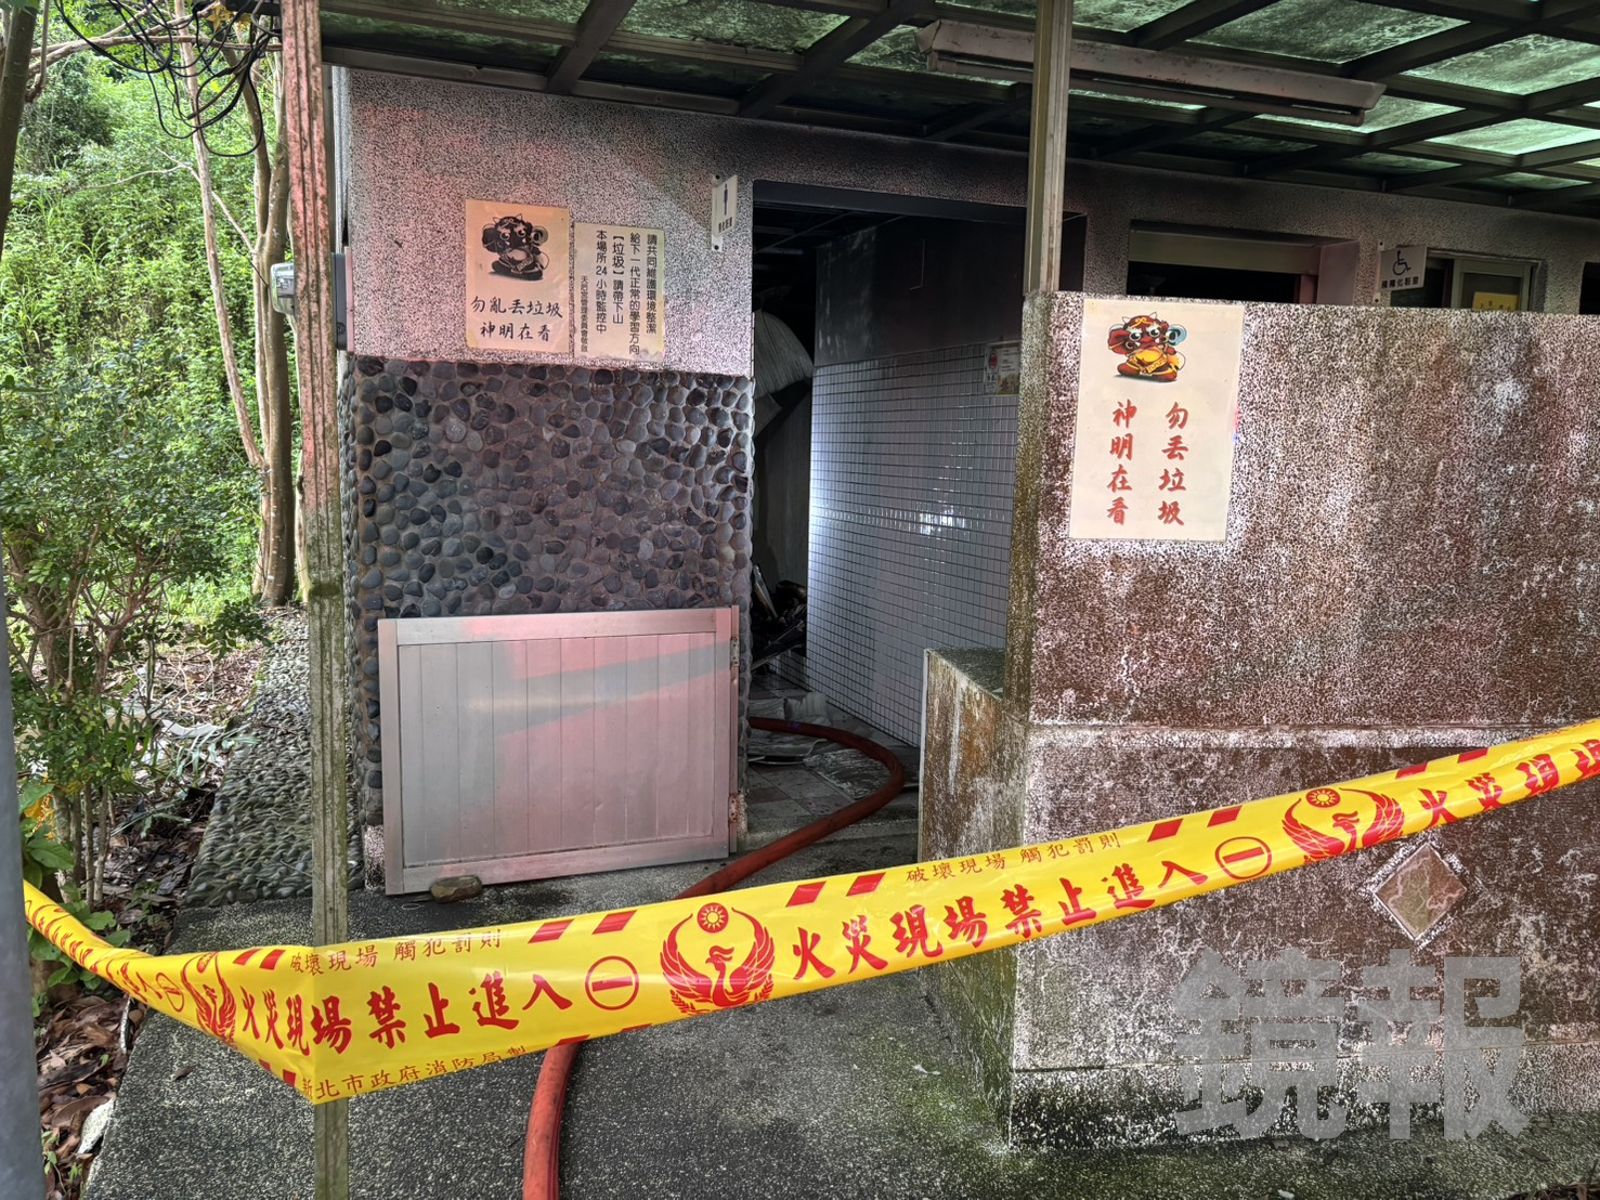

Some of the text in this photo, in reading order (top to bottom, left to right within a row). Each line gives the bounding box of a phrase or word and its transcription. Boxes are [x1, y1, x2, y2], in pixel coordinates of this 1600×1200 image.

[471, 295, 563, 319] 勿亂丟垃圾
[480, 322, 551, 342] 神明在看
[629, 232, 641, 356] 給下一代正常的學習方向
[1106, 399, 1137, 525] 神明在看
[1157, 401, 1189, 526] 勿丟垃圾
[905, 832, 1122, 883] 破壞現場 觸犯罰則
[289, 928, 502, 976] 破壞現場 觸犯罰則
[792, 861, 1209, 980] 火災現場禁止進入
[239, 973, 573, 1057] 火災現場禁止進入
